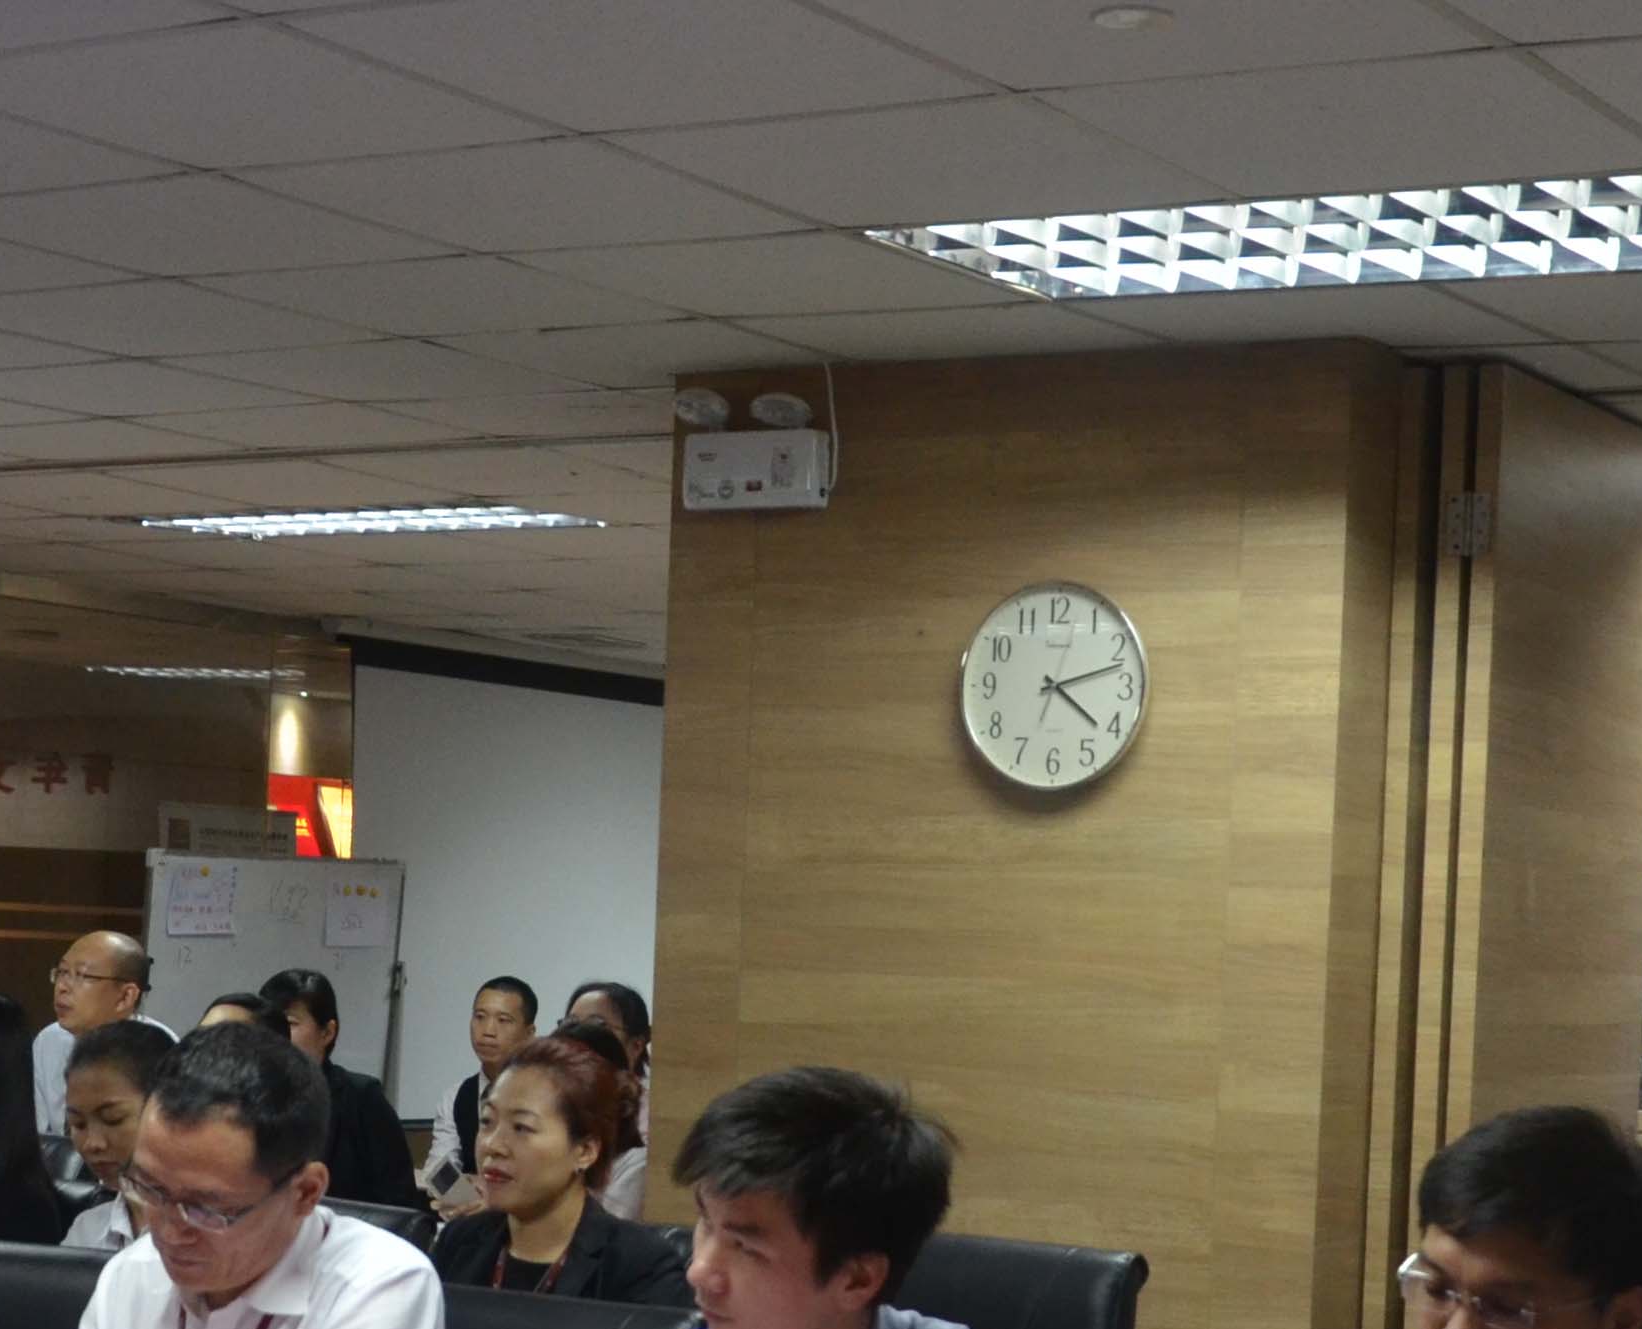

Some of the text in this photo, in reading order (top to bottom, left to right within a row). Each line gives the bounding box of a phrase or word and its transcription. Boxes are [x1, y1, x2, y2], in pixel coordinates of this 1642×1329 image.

[1018, 606, 1036, 635] 11
[1049, 596, 1071, 625] 12
[1091, 607, 1098, 635] 1
[991, 634, 1012, 663] 10
[1110, 632, 1126, 662] 2
[982, 671, 997, 700] 9
[1116, 671, 1134, 701] 3
[989, 710, 1003, 740] 8
[1106, 711, 1121, 740] 4
[1013, 736, 1029, 766] 7
[1045, 746, 1061, 776] 6
[1078, 737, 1095, 767] 5
